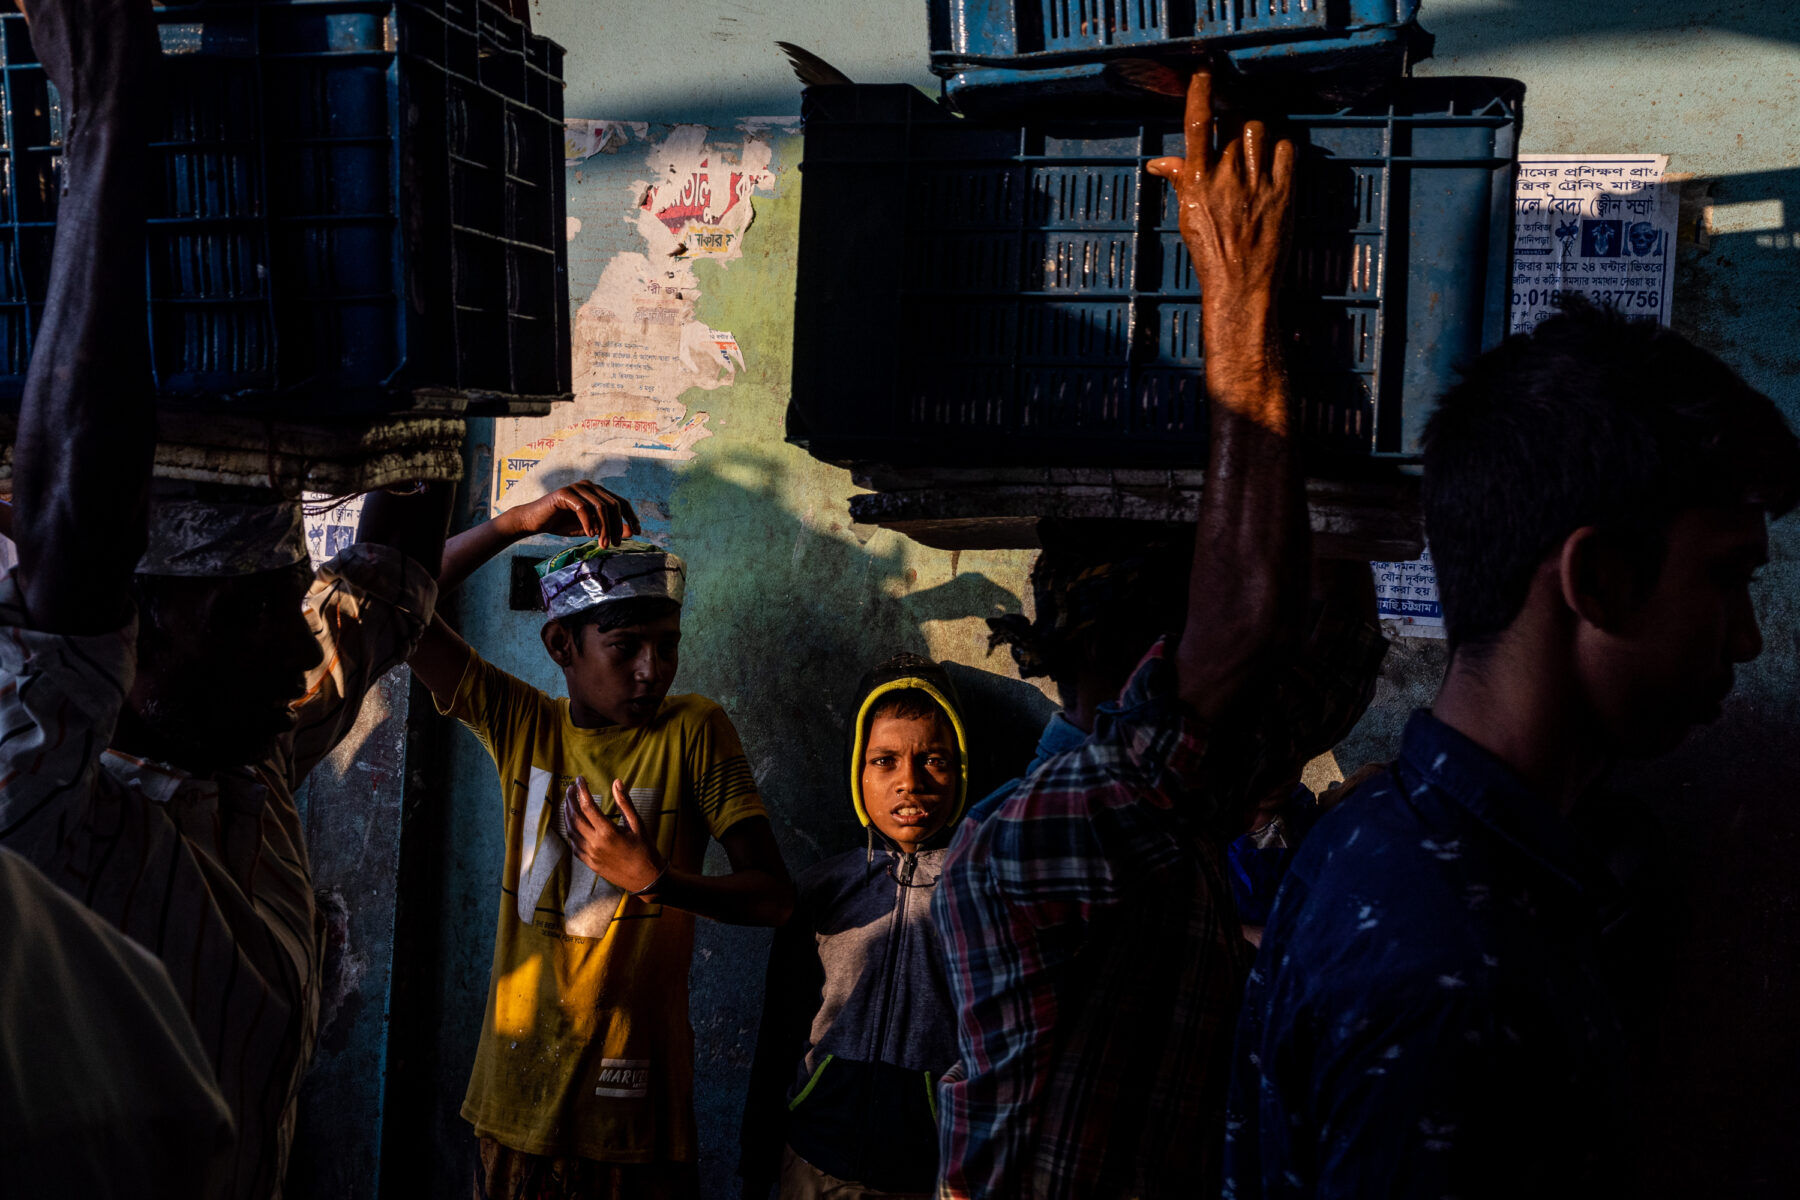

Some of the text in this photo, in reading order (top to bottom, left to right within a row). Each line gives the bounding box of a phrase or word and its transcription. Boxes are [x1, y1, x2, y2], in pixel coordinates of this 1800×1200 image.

[1564, 165, 1625, 177] প্রশিক্ষণ
[1558, 179, 1604, 191] ট্রেনিং
[1547, 192, 1584, 215] বৈদ্য
[1582, 262, 1596, 272] ২৪
[1630, 260, 1663, 272] ভিতরে
[1592, 290, 1659, 308] 337756
